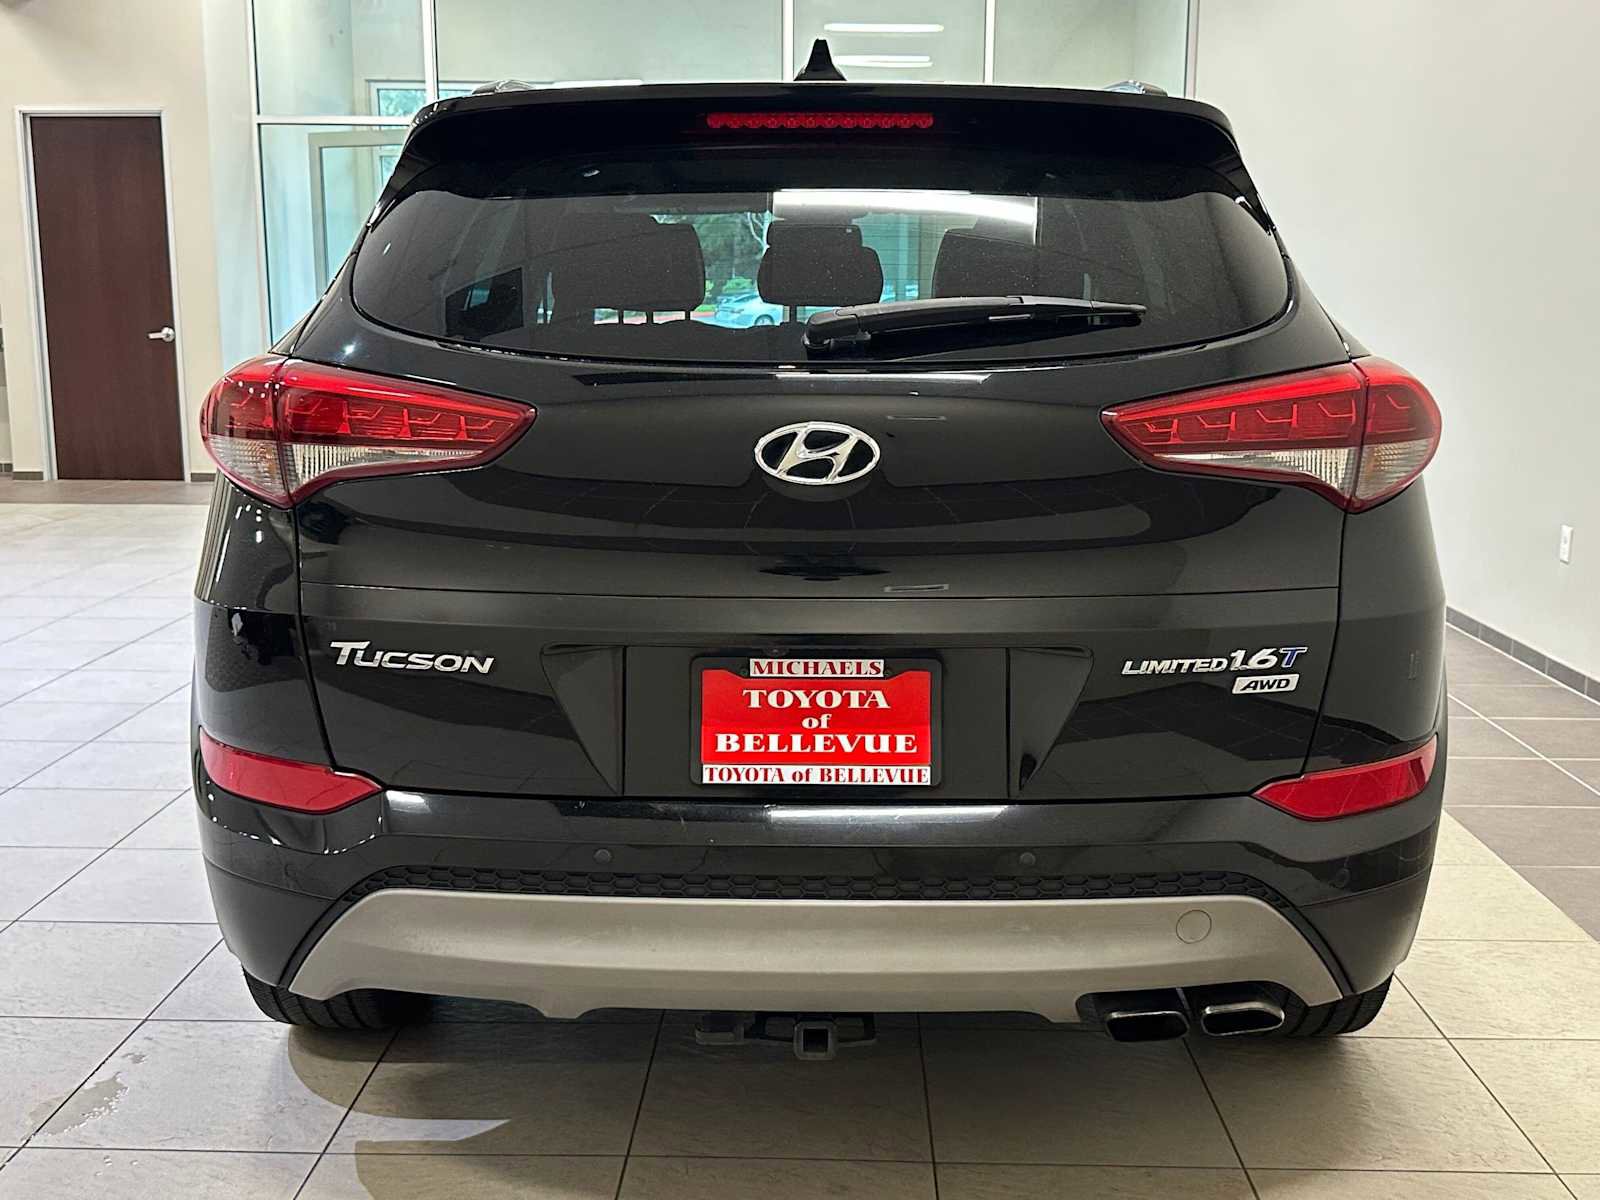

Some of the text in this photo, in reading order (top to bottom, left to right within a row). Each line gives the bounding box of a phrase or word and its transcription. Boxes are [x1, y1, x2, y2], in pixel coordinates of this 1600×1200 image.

[330, 641, 494, 674] TUCSON
[1121, 657, 1228, 675] LIMITED
[752, 660, 882, 676] MICHAELS
[1241, 678, 1290, 691] AWD
[742, 689, 890, 709] TOYOTA
[801, 713, 833, 729] of
[715, 733, 918, 753] BELLEVUE
[704, 766, 930, 783] TOYOTA of BELLEVUE
